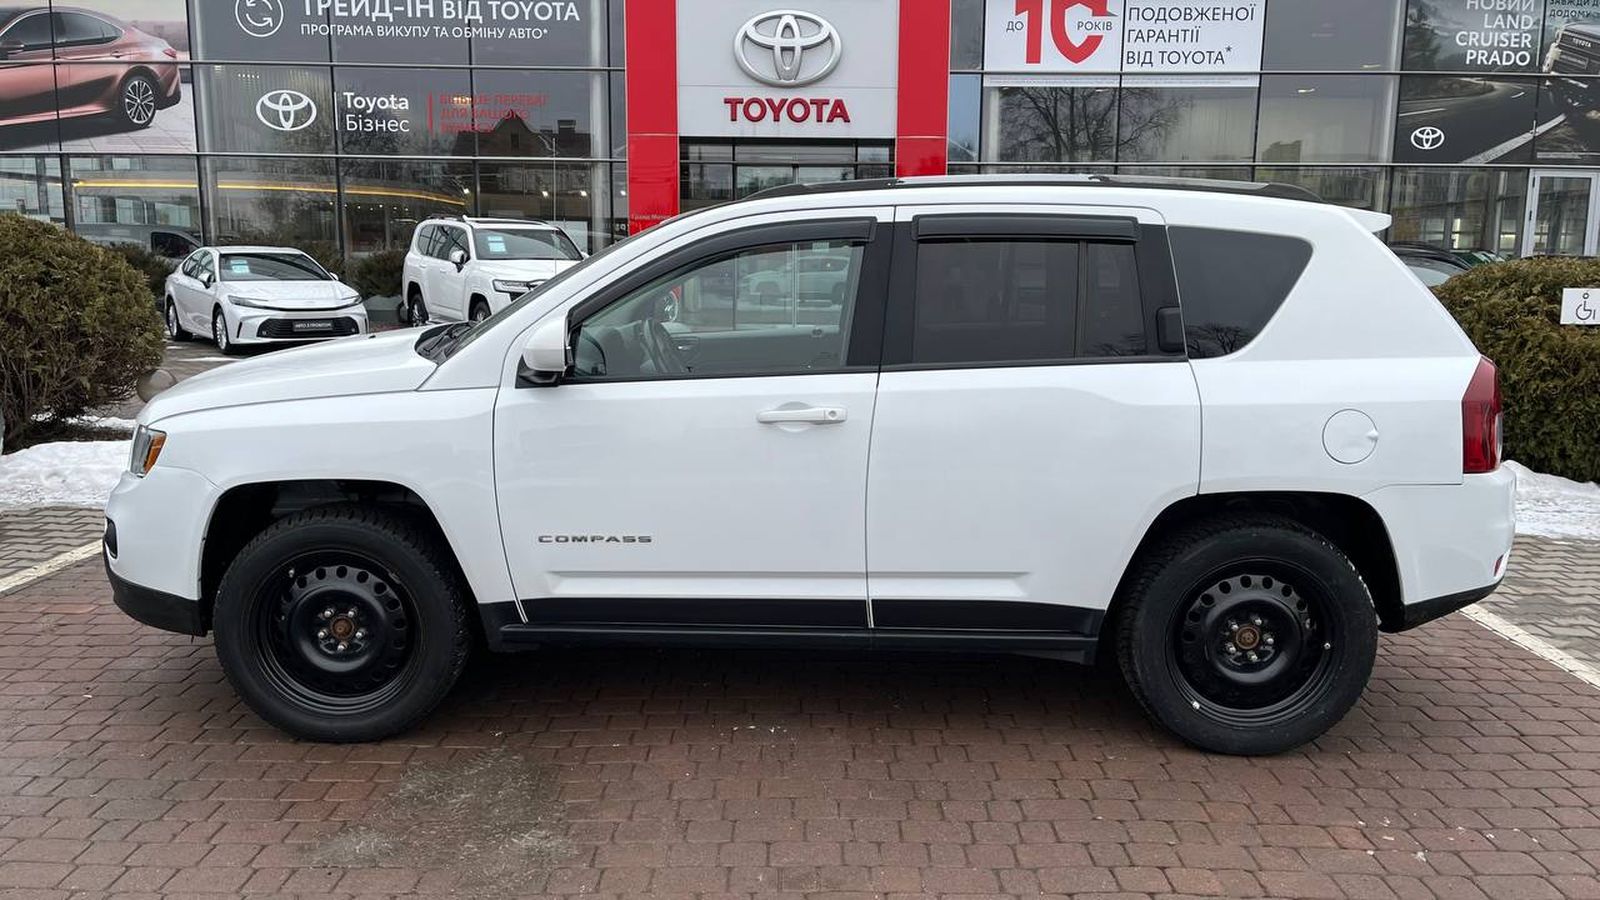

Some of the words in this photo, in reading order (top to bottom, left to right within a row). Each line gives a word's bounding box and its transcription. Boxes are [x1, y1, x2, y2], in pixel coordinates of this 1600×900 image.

[442, 0, 483, 24] ВІД
[487, 1, 580, 21] TOYOTA
[1128, 3, 1257, 24] ПОДОВЖЕНОЇ
[1006, 20, 1024, 33] ДО
[1077, 20, 1113, 31] РОКІВ
[1484, 13, 1534, 30] LAND
[300, 23, 374, 37] ПРОГРАМА
[376, 25, 431, 38] ВИКУПУ
[433, 26, 449, 38] ТА
[451, 26, 506, 39] ОБМІНУ
[1127, 25, 1201, 43] ГАРАНТІЇ
[1456, 31, 1532, 48] CRUISER
[1126, 50, 1153, 67] ВІД
[1465, 49, 1531, 66] PRADO
[343, 92, 409, 113] Toyota
[723, 97, 851, 123] TOYOTA
[345, 114, 410, 132] Бізнес
[538, 535, 653, 543] COMPASS
